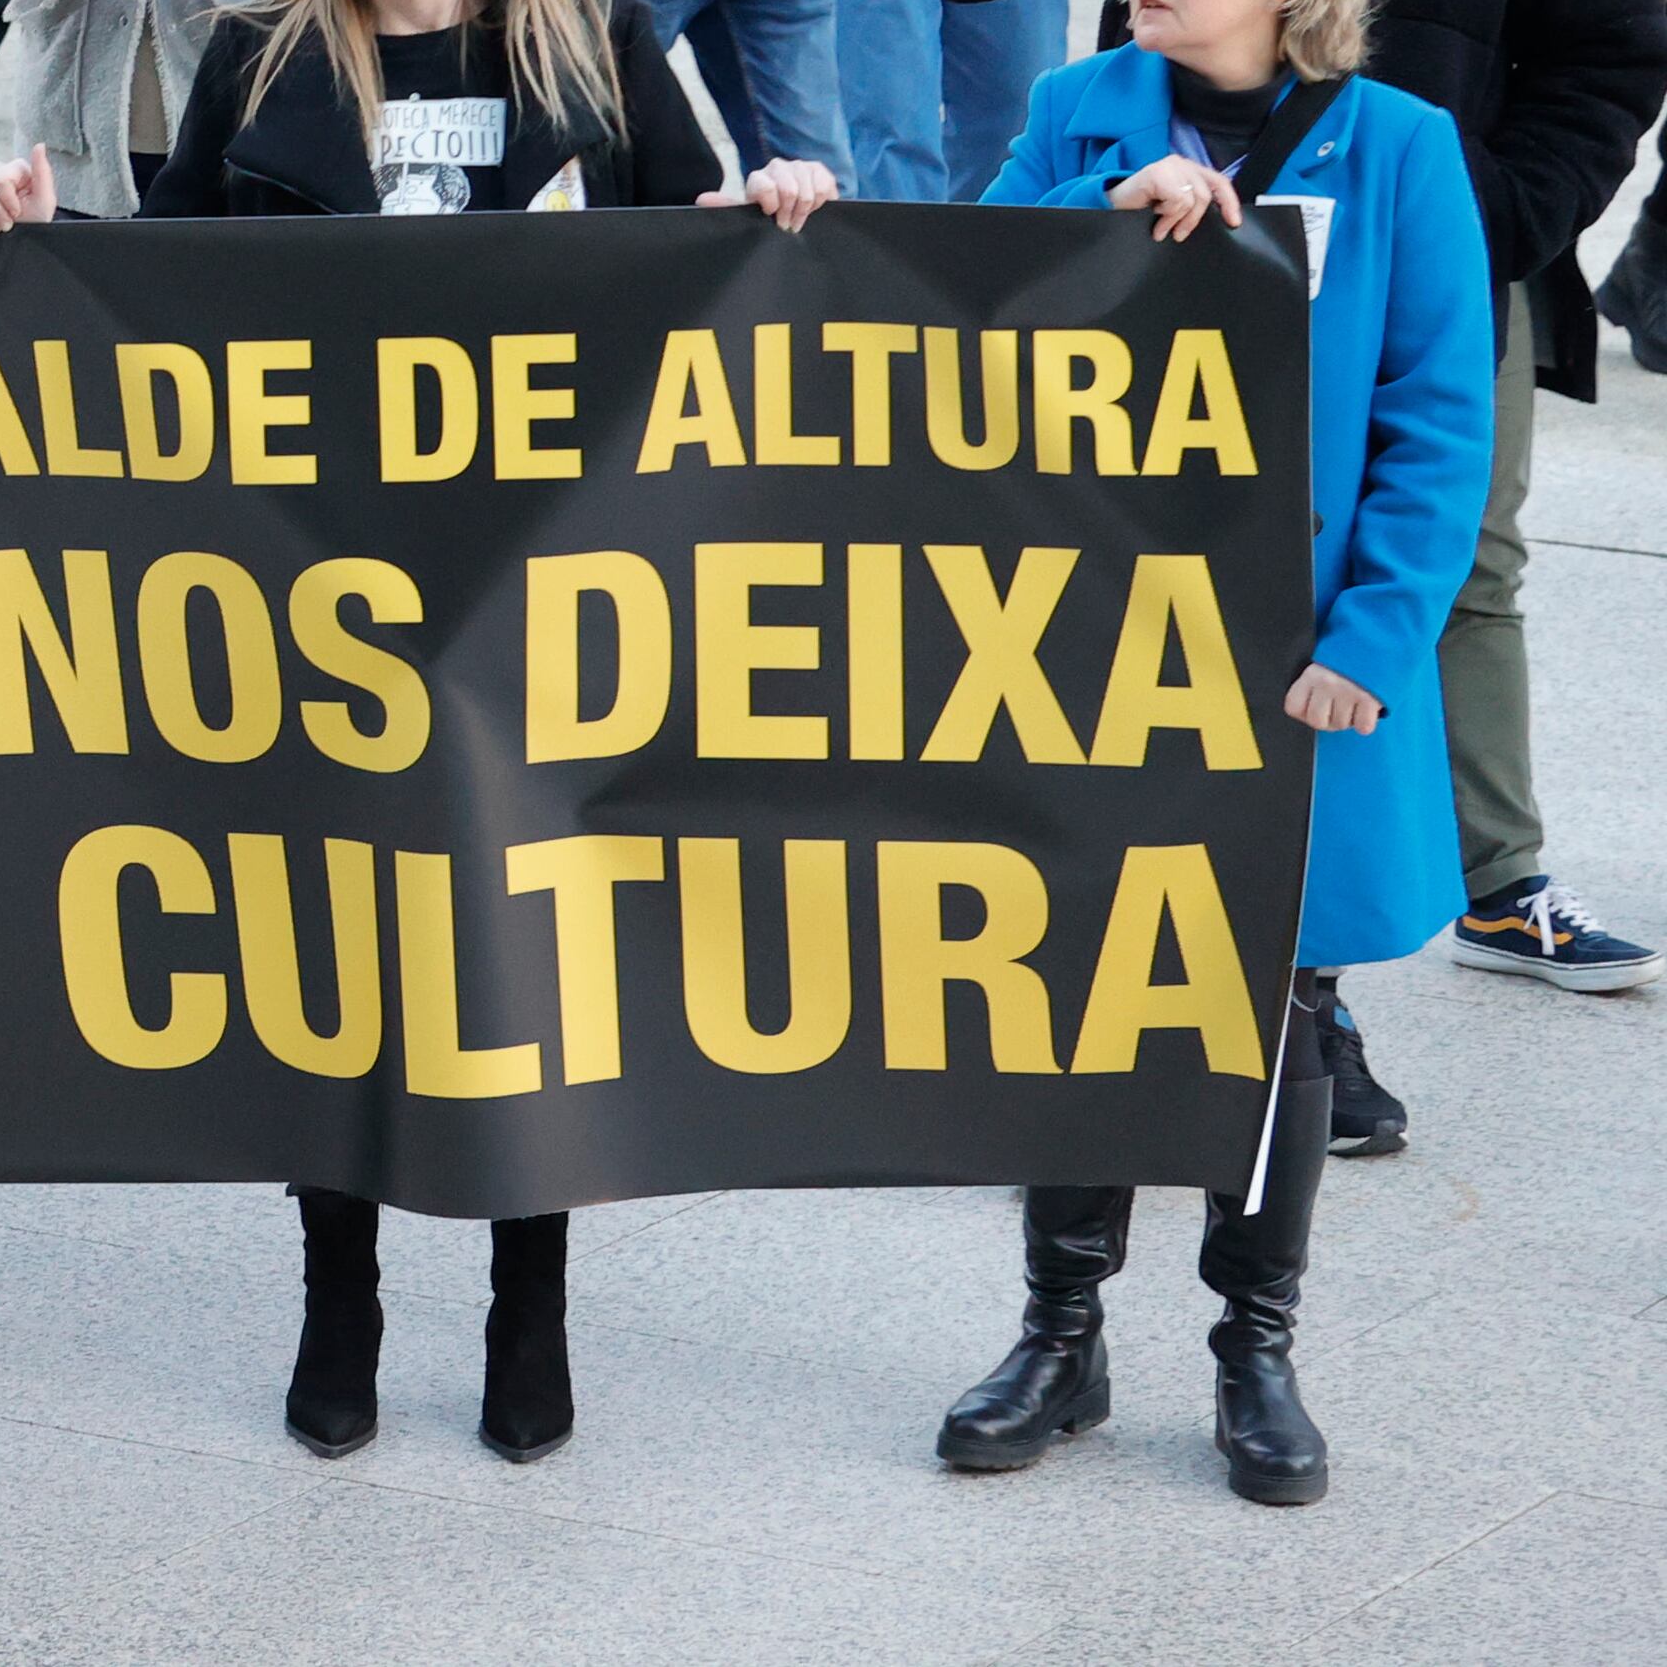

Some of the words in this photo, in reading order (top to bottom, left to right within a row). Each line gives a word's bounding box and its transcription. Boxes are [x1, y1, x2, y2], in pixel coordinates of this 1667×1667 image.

[379, 102, 431, 130] OTECA
[437, 101, 498, 128] MERECE
[380, 129, 501, 165] PECTO!!!
[376, 332, 584, 484] DE
[635, 321, 1260, 478] ALTURA
[524, 541, 1265, 772] DEIXA
[58, 825, 1267, 1100] CULTURA
